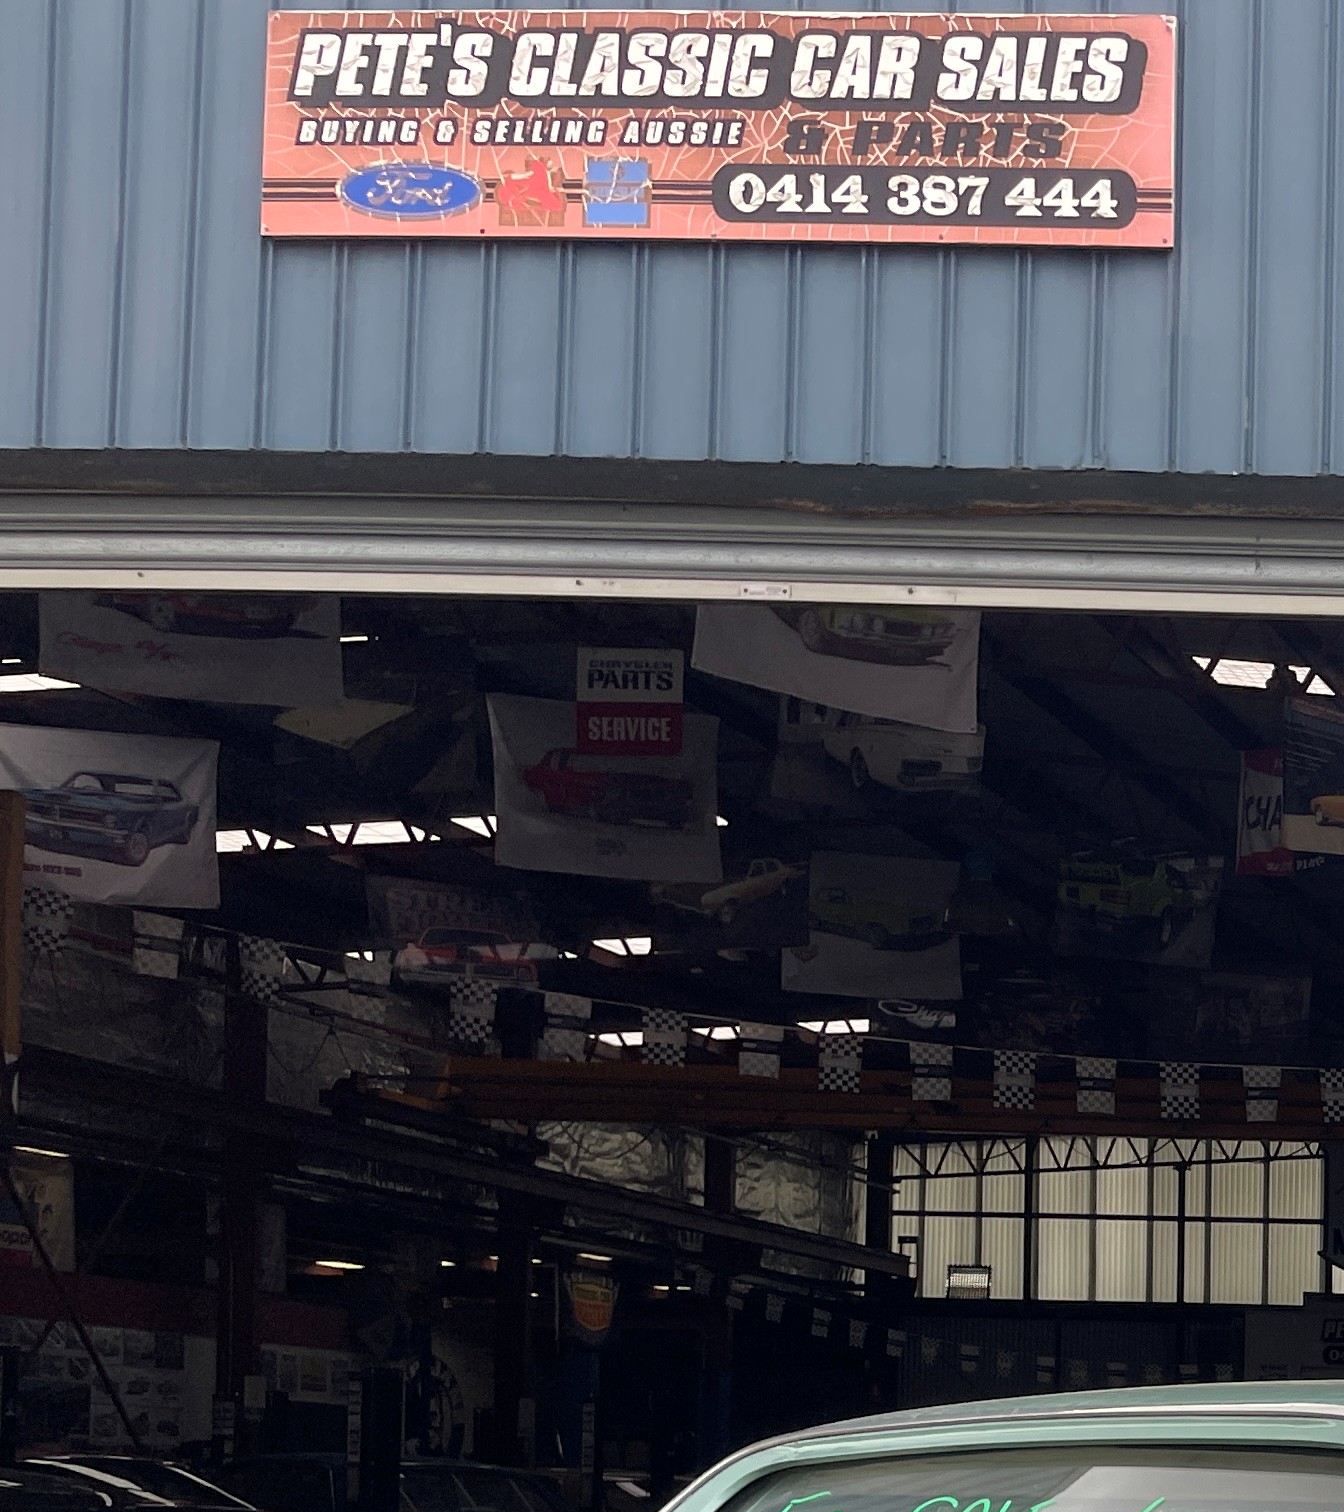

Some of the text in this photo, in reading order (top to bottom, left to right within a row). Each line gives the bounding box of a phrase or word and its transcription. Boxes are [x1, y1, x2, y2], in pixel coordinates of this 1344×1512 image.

[292, 22, 1130, 103] PETE'S CLASSIC CAR SALES
[297, 119, 745, 147] BUYING & SELLING AUSSIE
[785, 119, 1067, 159] & PARTS
[727, 175, 1118, 219] 0414 387 444
[587, 669, 674, 692] PARTS
[587, 715, 673, 743] SERVICE
